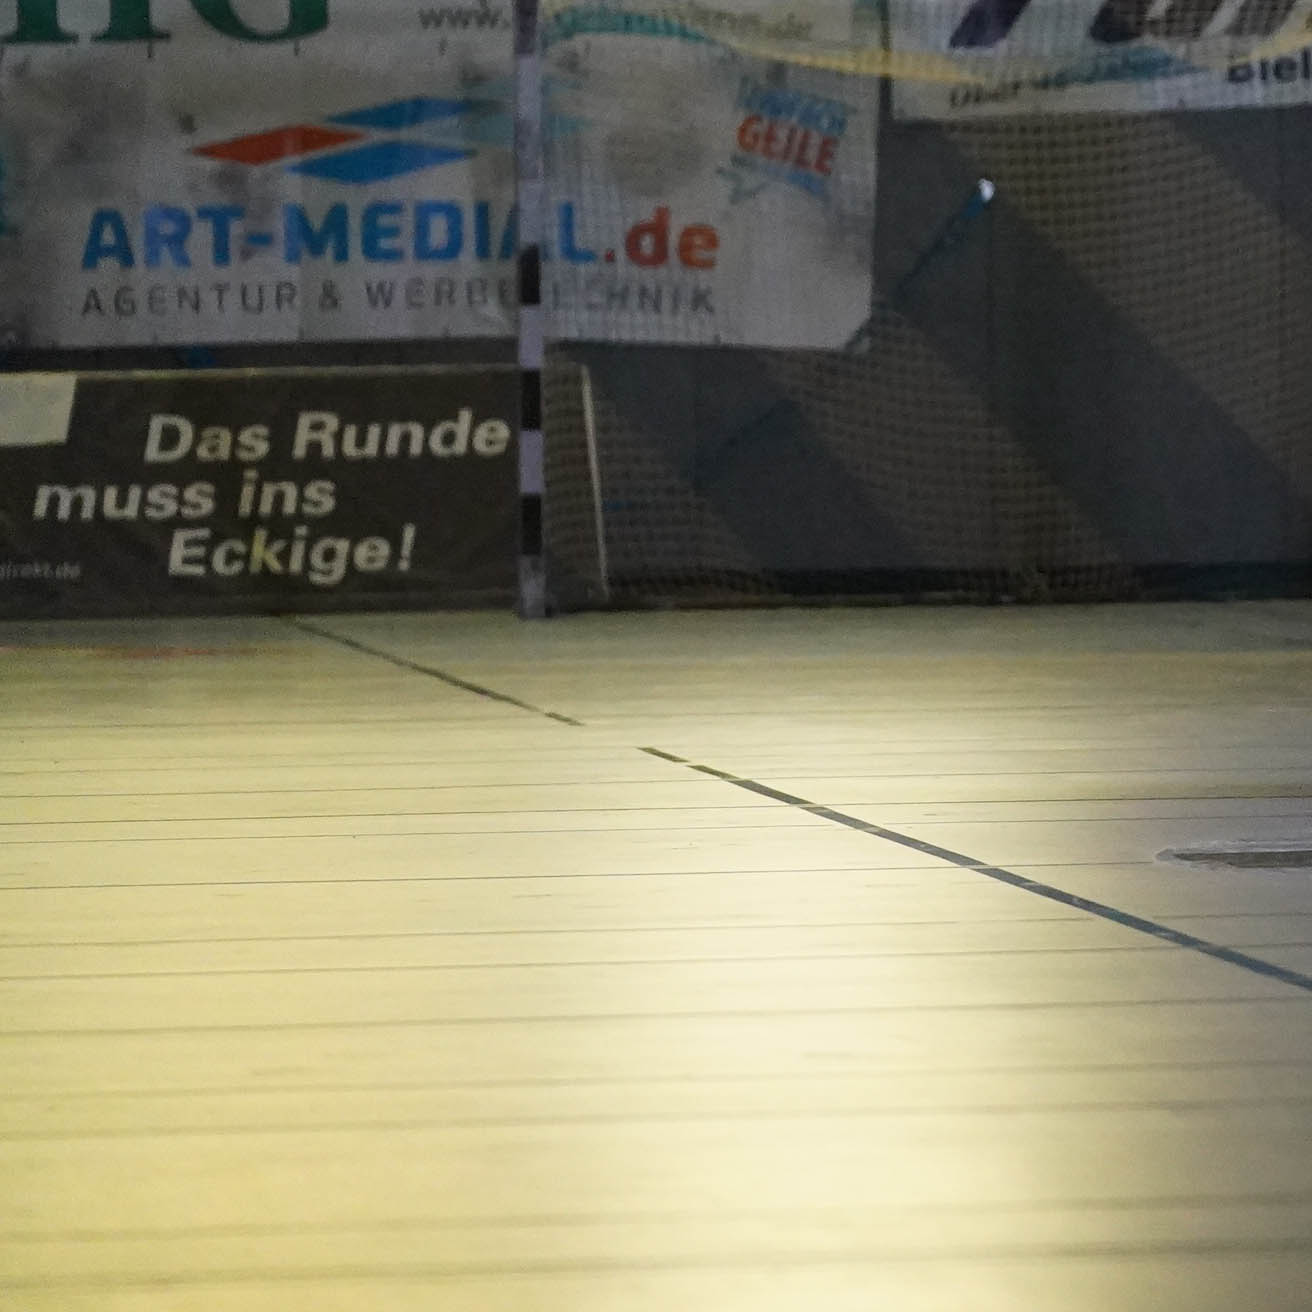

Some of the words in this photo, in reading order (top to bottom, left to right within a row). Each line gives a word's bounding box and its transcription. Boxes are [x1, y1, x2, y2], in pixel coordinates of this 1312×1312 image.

[737, 114, 839, 177] GEILE
[81, 280, 299, 317] AGENTUR
[143, 412, 271, 464] Das
[292, 406, 511, 462] Runde
[32, 482, 216, 524] muss
[236, 468, 337, 520] ins
[168, 522, 418, 586] Eckige!
